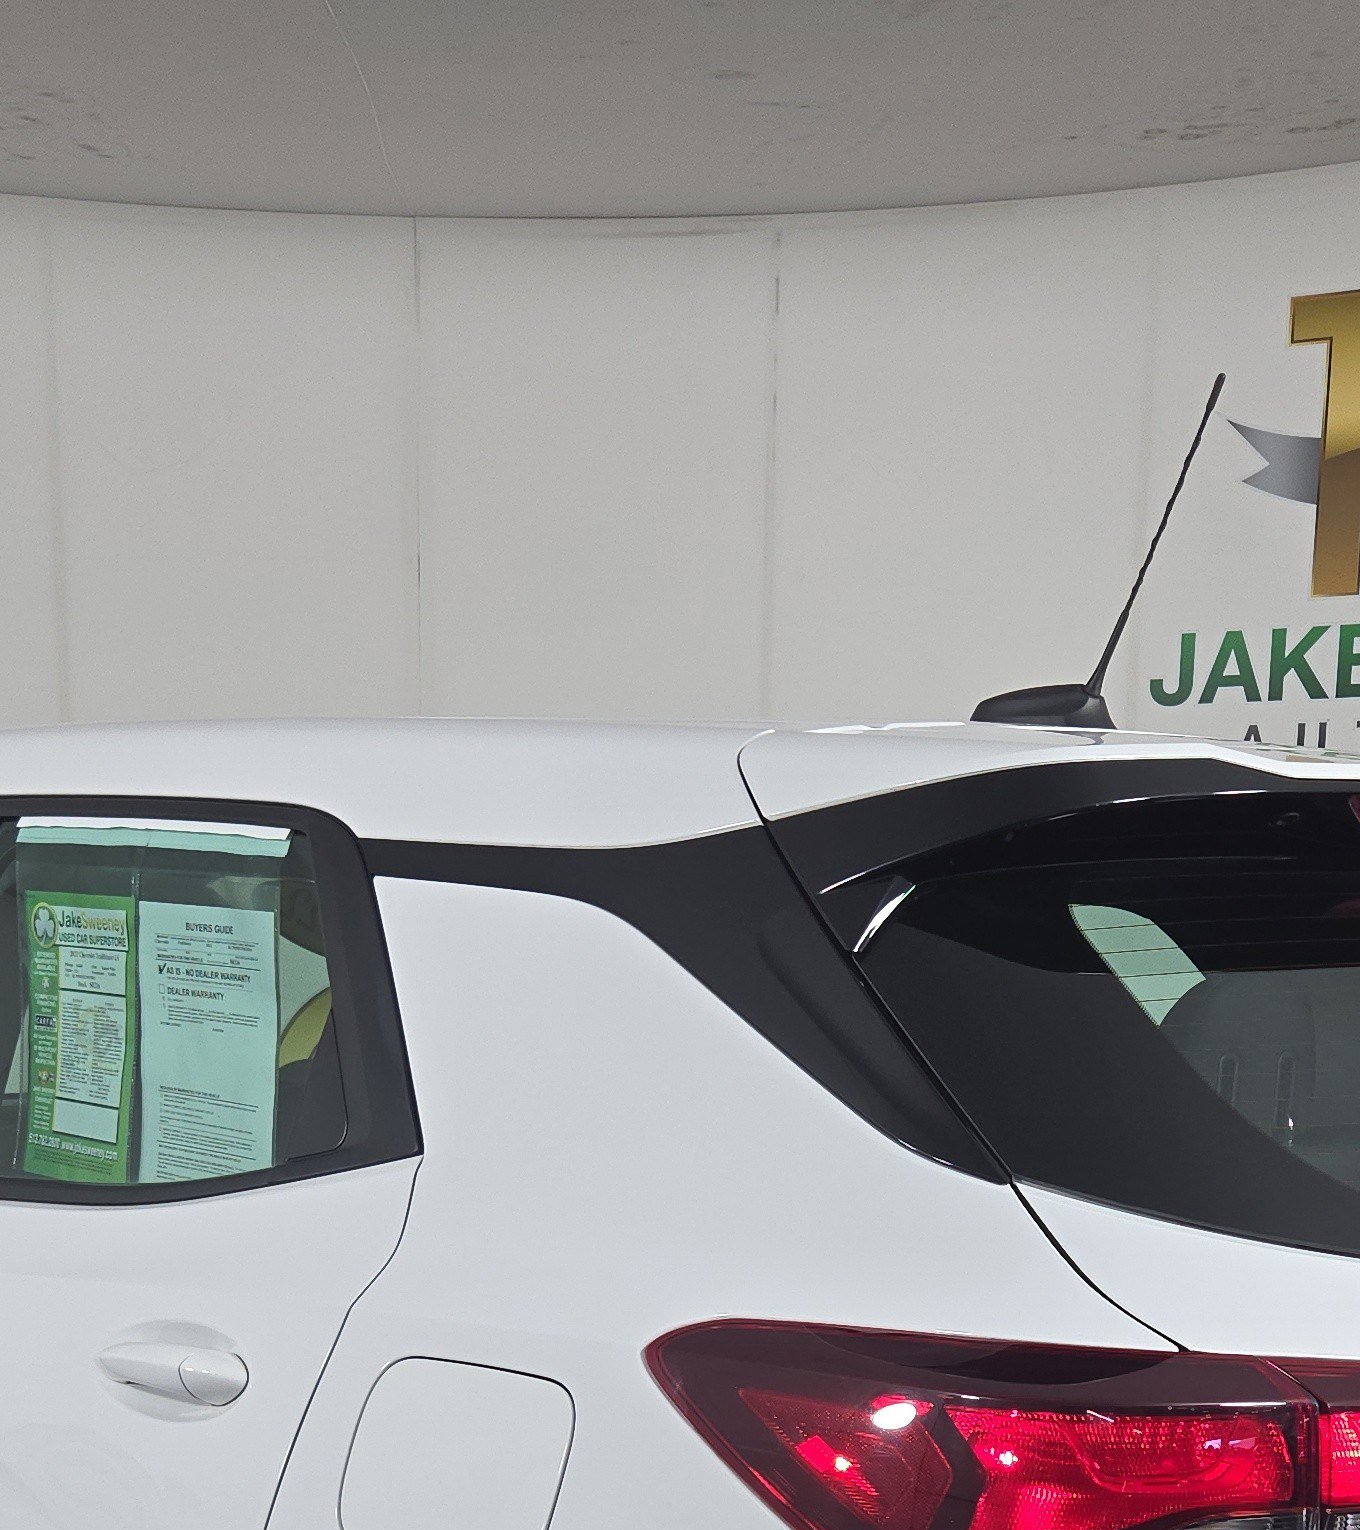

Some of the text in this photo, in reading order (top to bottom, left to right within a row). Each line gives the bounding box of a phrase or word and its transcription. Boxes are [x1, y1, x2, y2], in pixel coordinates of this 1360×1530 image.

[58, 910, 125, 936] JakeSweeney
[185, 922, 234, 935] BUYERS GUIDE
[58, 932, 127, 947] USED CAR SUPERSTORE
[195, 969, 219, 980] DEALER
[220, 972, 251, 983] WARRANTY
[167, 986, 225, 1001] DEALER WARRANTY
